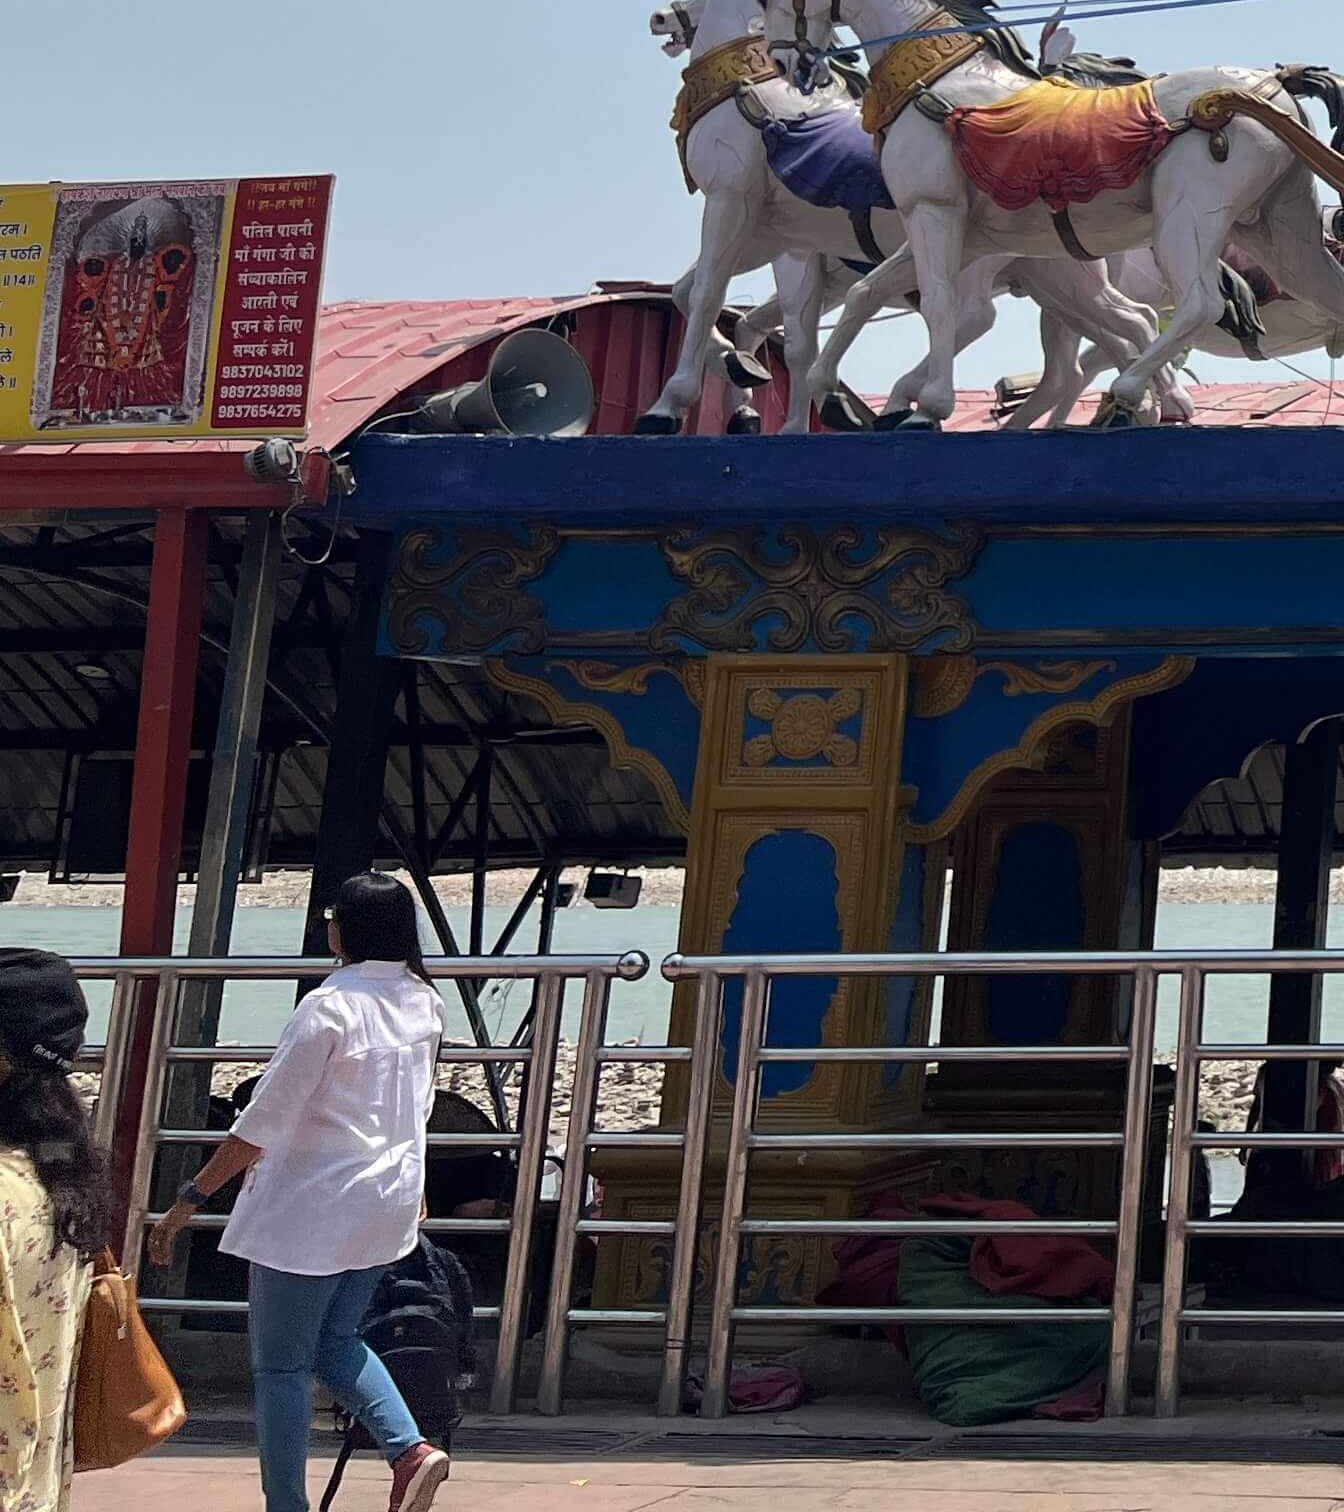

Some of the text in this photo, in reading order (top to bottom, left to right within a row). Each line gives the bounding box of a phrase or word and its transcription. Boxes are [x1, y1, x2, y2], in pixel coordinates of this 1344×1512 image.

[242, 218, 314, 238] पतित पावनी
[11, 245, 41, 260] पठति
[252, 244, 277, 261] गंगा
[279, 242, 296, 260] जी
[298, 242, 316, 260] की
[242, 291, 299, 310] आरती एवं
[231, 315, 303, 339] पूजन के लिए
[232, 338, 267, 358] सम्पर्क
[222, 364, 304, 379] 9837043102
[220, 384, 303, 399] 9897239898
[218, 404, 302, 419] 9837654275
